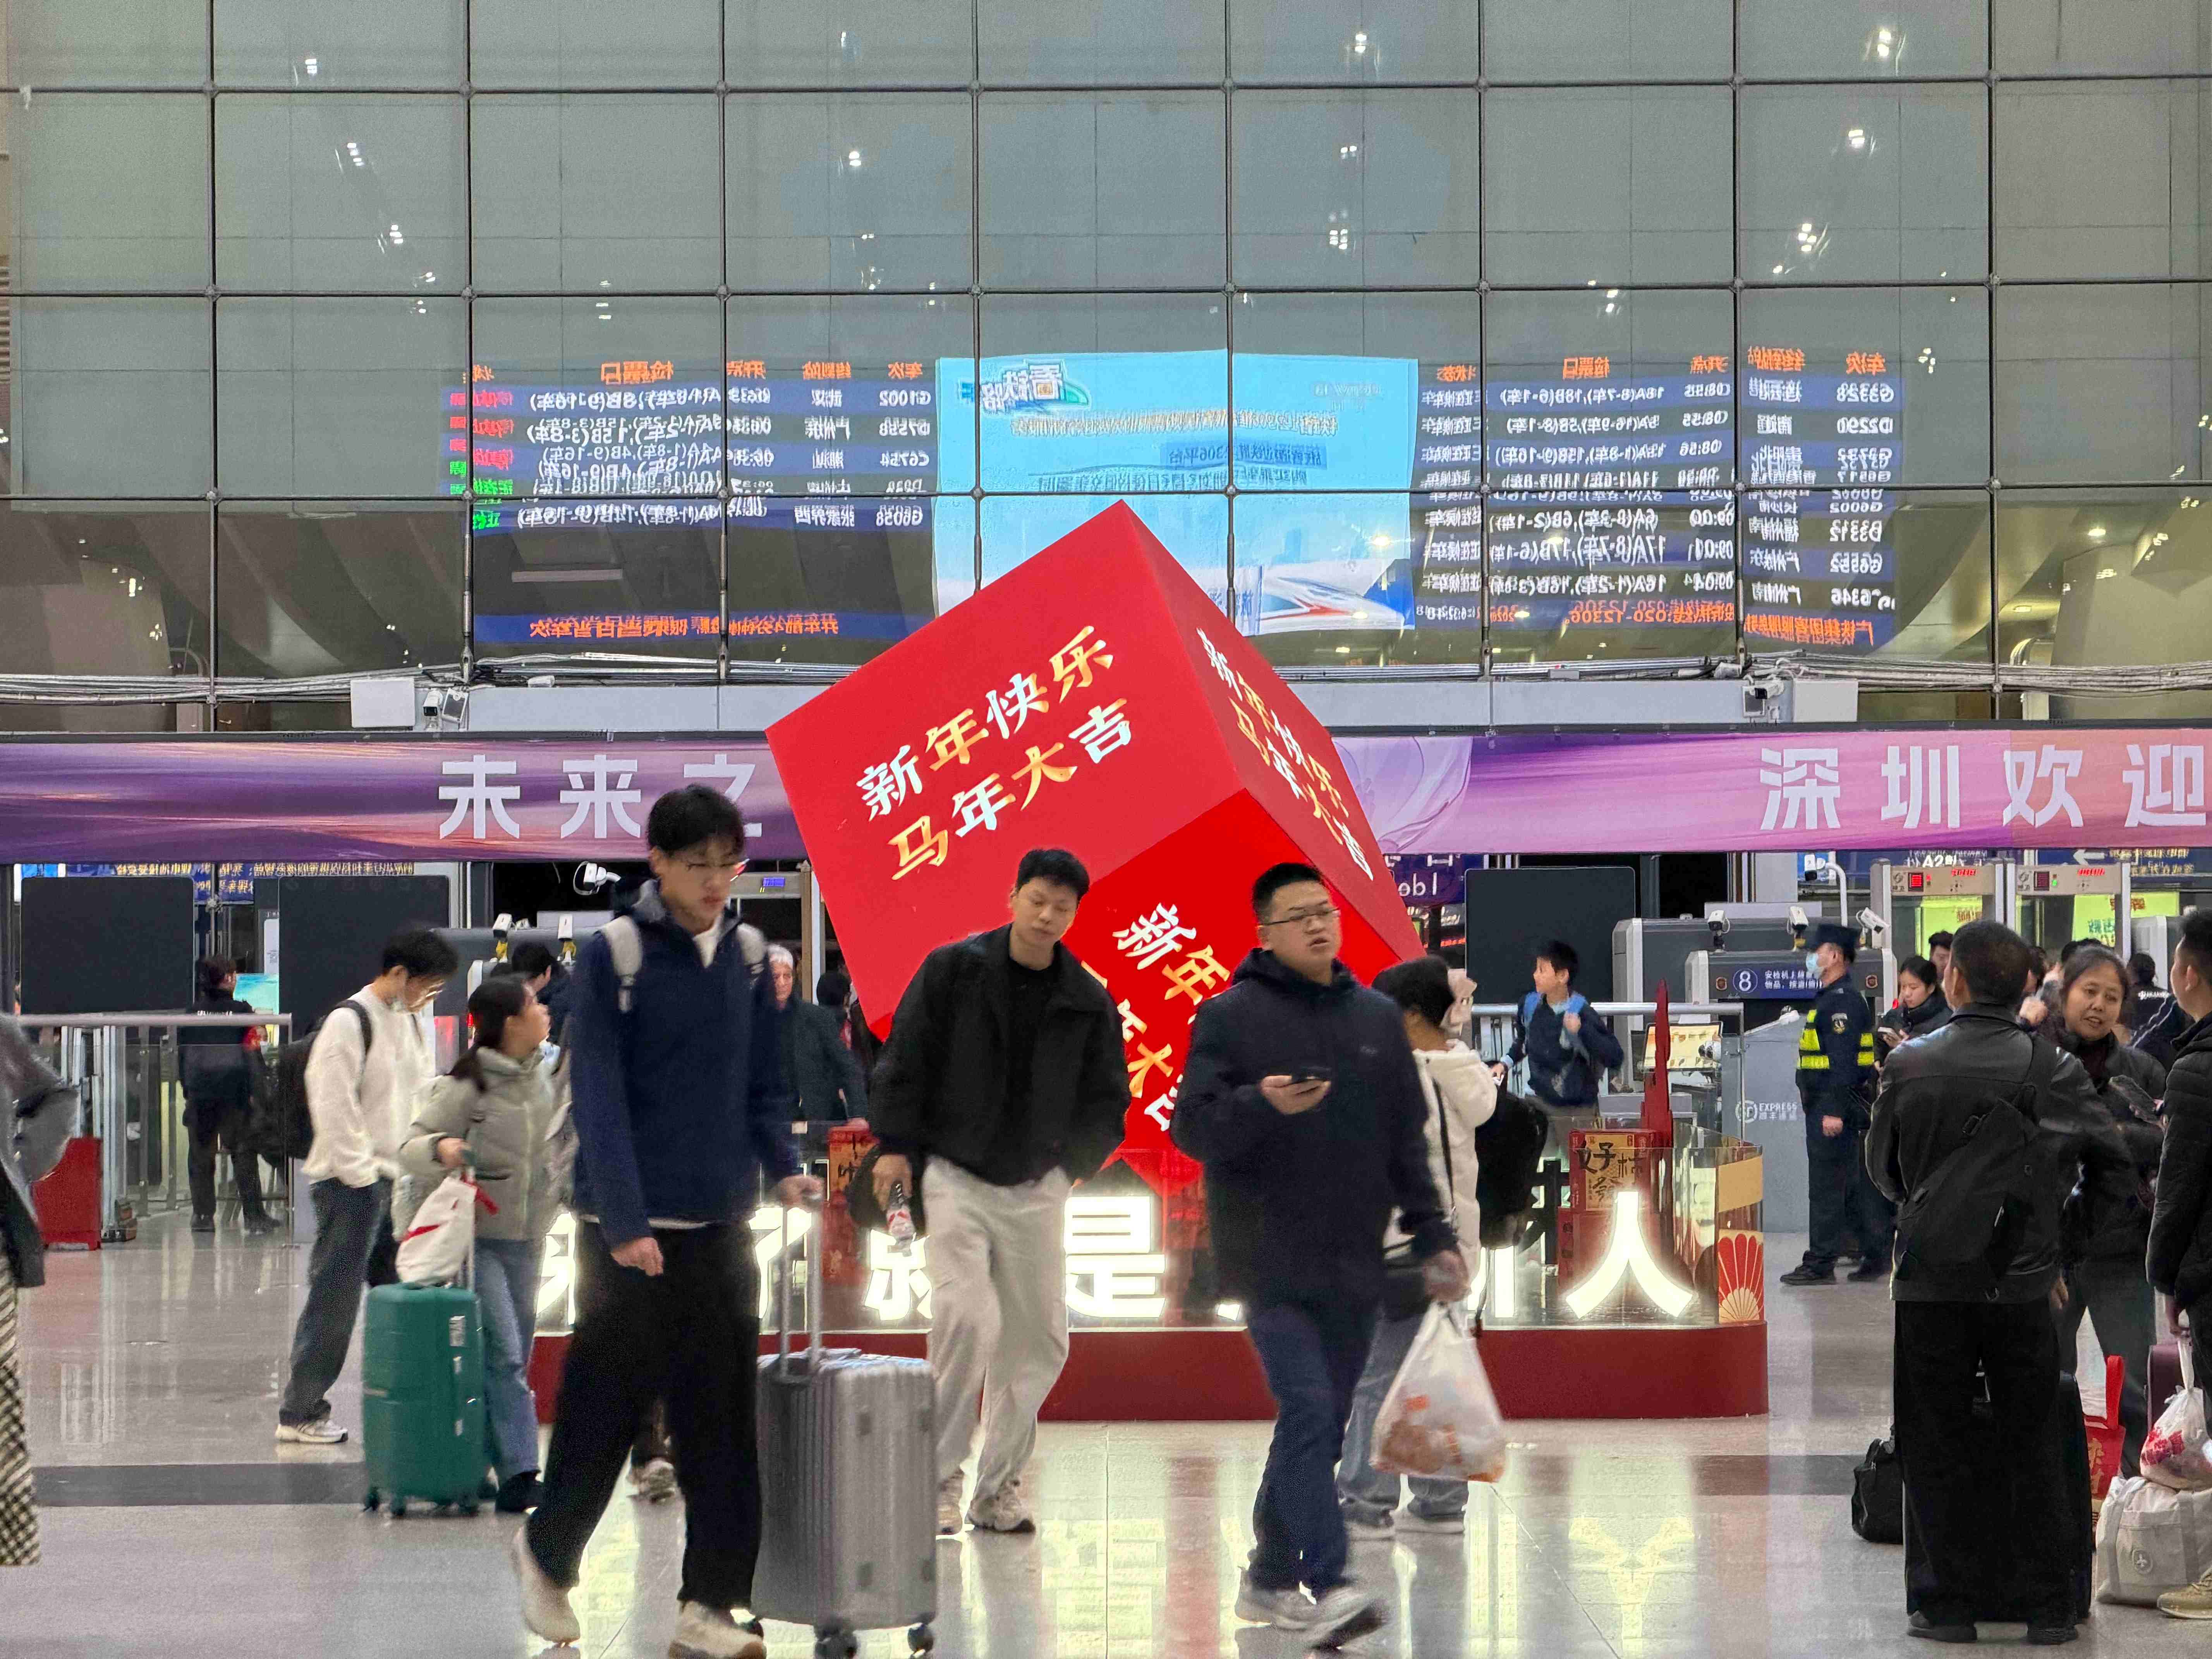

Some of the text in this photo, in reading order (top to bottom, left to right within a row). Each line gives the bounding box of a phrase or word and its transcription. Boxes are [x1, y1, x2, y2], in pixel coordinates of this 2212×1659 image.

[856, 625, 1113, 822] 新年快乐
[888, 698, 1131, 880] 马年大吉
[1196, 627, 1349, 818] 新年快乐
[1228, 696, 1374, 881] 马年大吉
[1760, 743, 2207, 831] 深圳欢迎
[1739, 970, 1752, 992] 8
